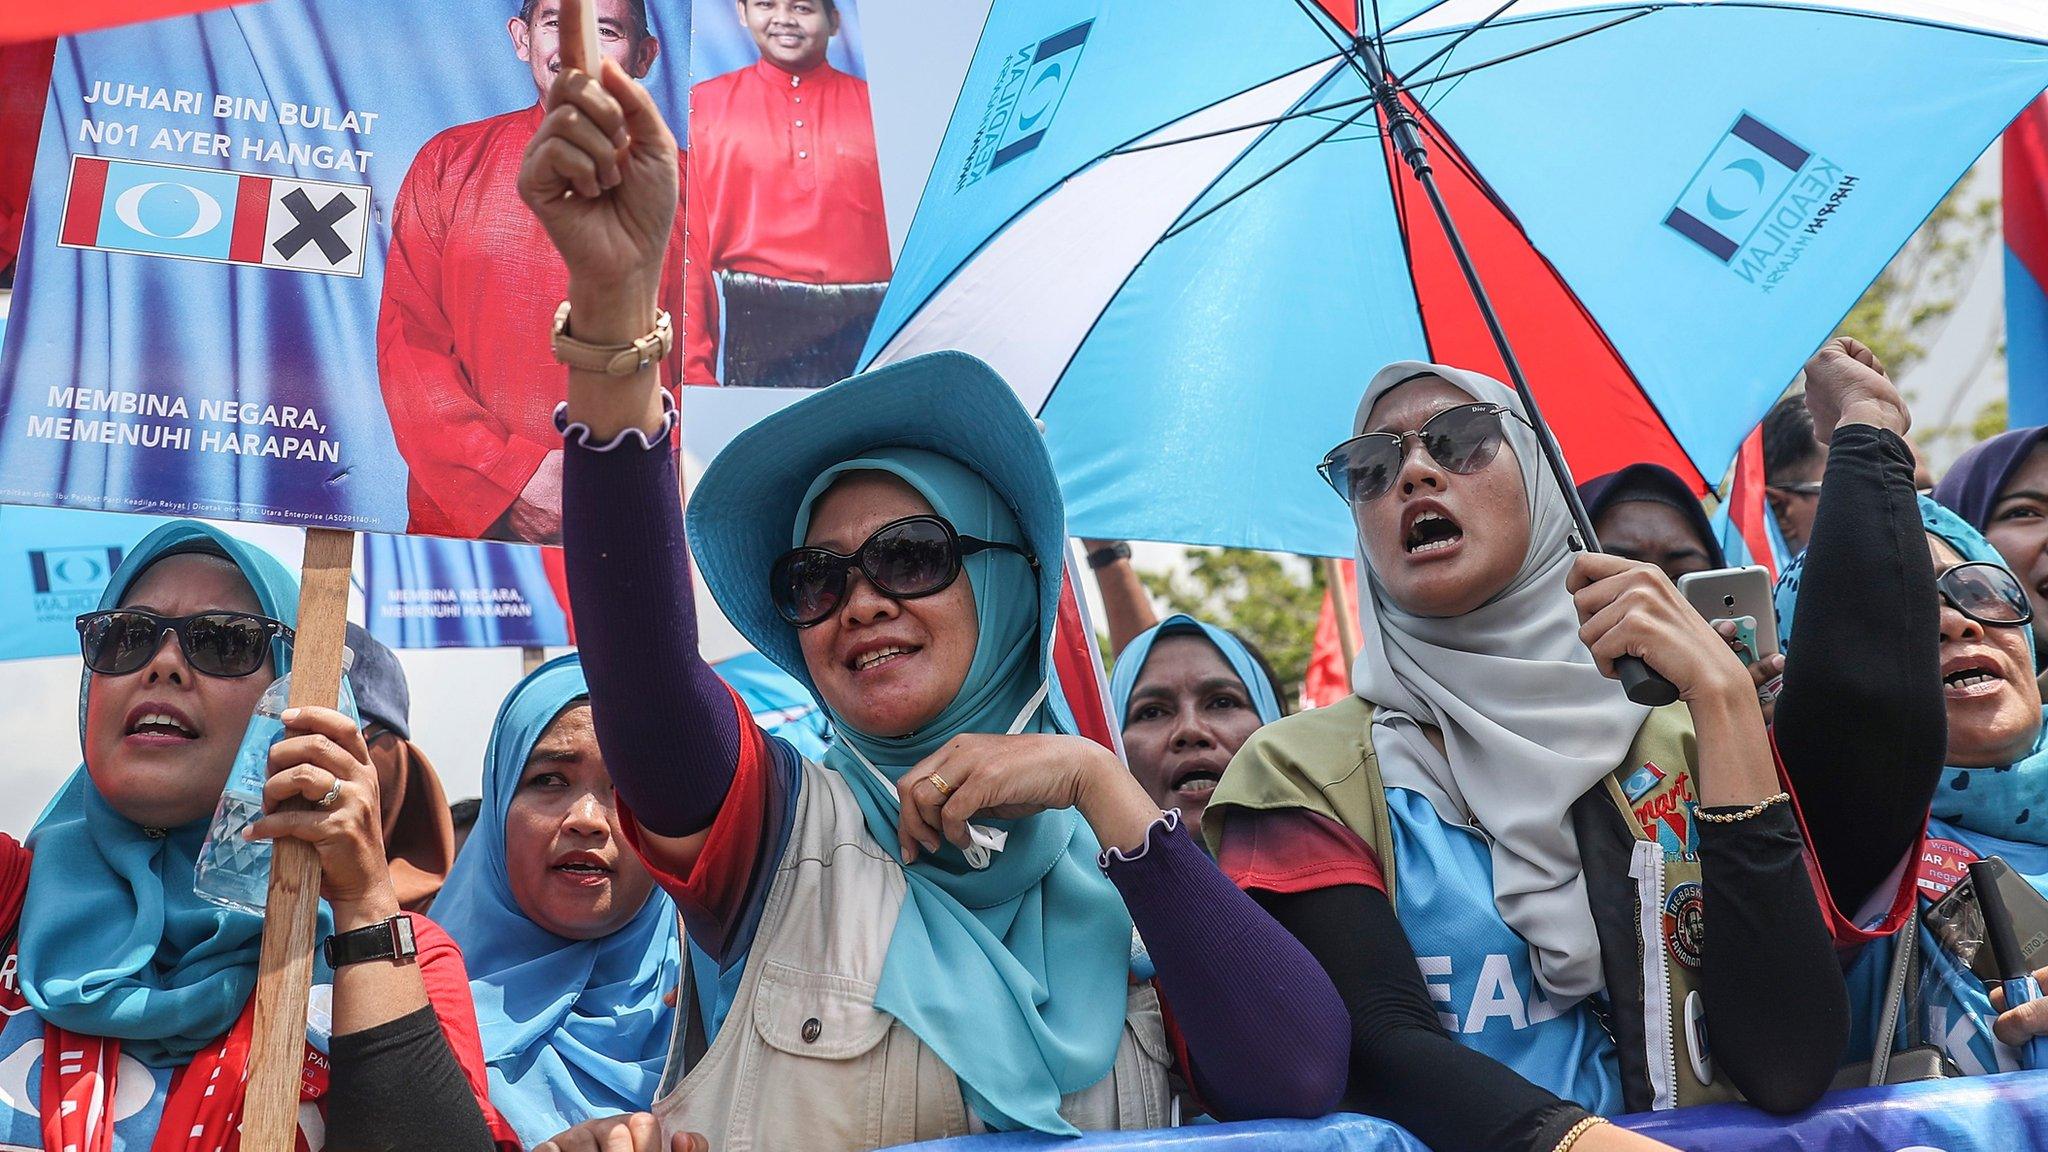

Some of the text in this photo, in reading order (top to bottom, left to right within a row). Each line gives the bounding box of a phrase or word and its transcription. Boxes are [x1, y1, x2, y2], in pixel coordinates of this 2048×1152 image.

[83, 80, 378, 135] JUHARI BIN BULAT
[79, 119, 373, 174] N01 AYER HANGAT
[47, 385, 327, 434] MEMBINA NEGARA,
[26, 415, 340, 463] MEMENUHI HARAPAN
[123, 497, 157, 507] Keadilan
[159, 500, 186, 511] Rakyat
[261, 508, 282, 517] Utara
[284, 510, 323, 522] Enterprise
[380, 603, 533, 618] MEMENUHI HARAPAN
[387, 588, 457, 603] MEMBINA
[1633, 772, 1692, 826] mart
[1930, 841, 1970, 857] wanita
